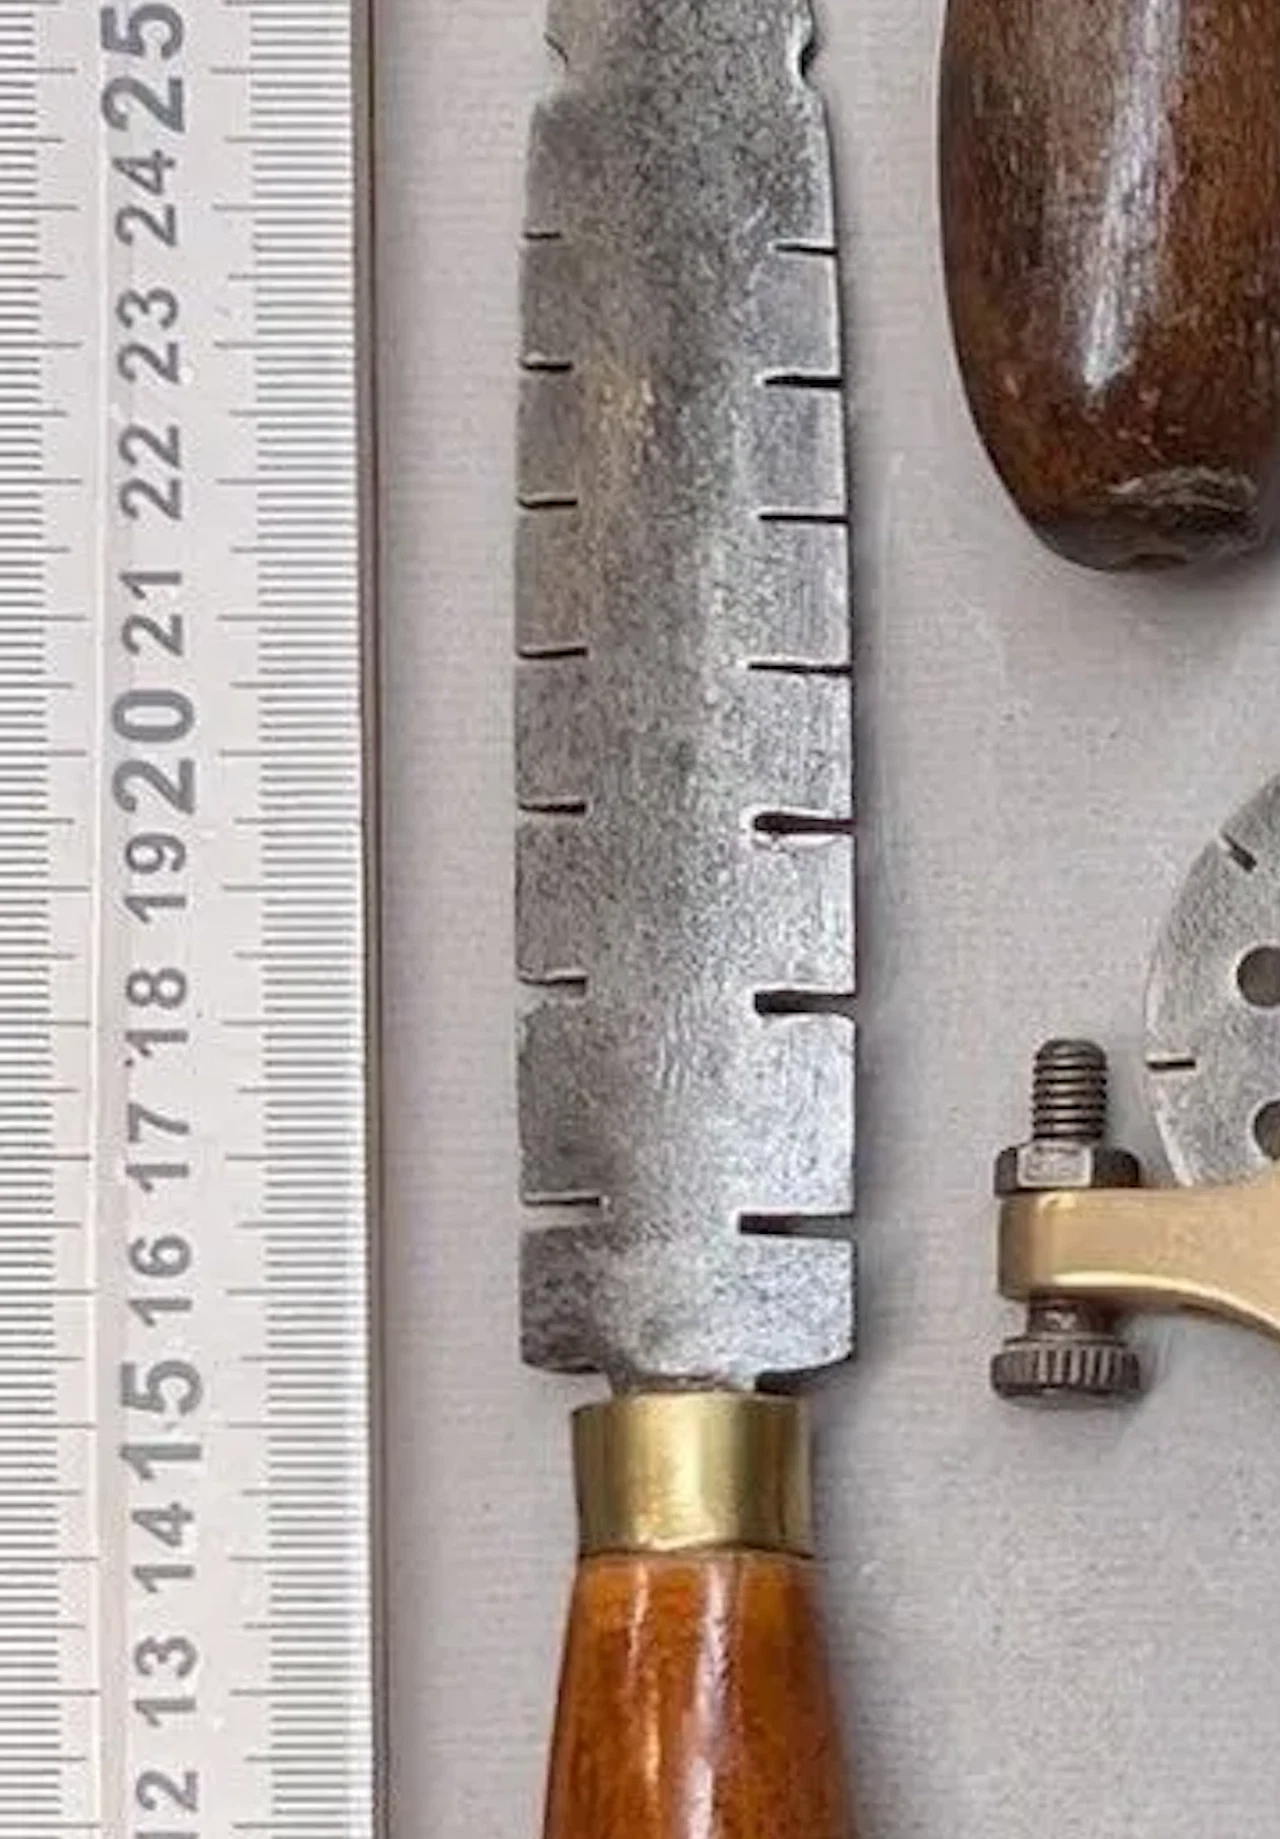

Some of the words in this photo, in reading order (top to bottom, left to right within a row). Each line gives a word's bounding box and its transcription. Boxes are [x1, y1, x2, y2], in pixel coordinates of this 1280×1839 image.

[100, 3, 185, 133] 25
[111, 149, 177, 248] 24
[114, 288, 180, 385] 23
[116, 423, 182, 521] 22
[117, 570, 184, 657] 21
[109, 689, 195, 816] 20
[122, 832, 187, 924] 19
[123, 968, 189, 1058] 18
[125, 1102, 190, 1193] 17
[126, 1235, 192, 1327] 16
[116, 1360, 203, 1481] 15
[130, 1502, 195, 1593] 14
[132, 1637, 197, 1728] 13
